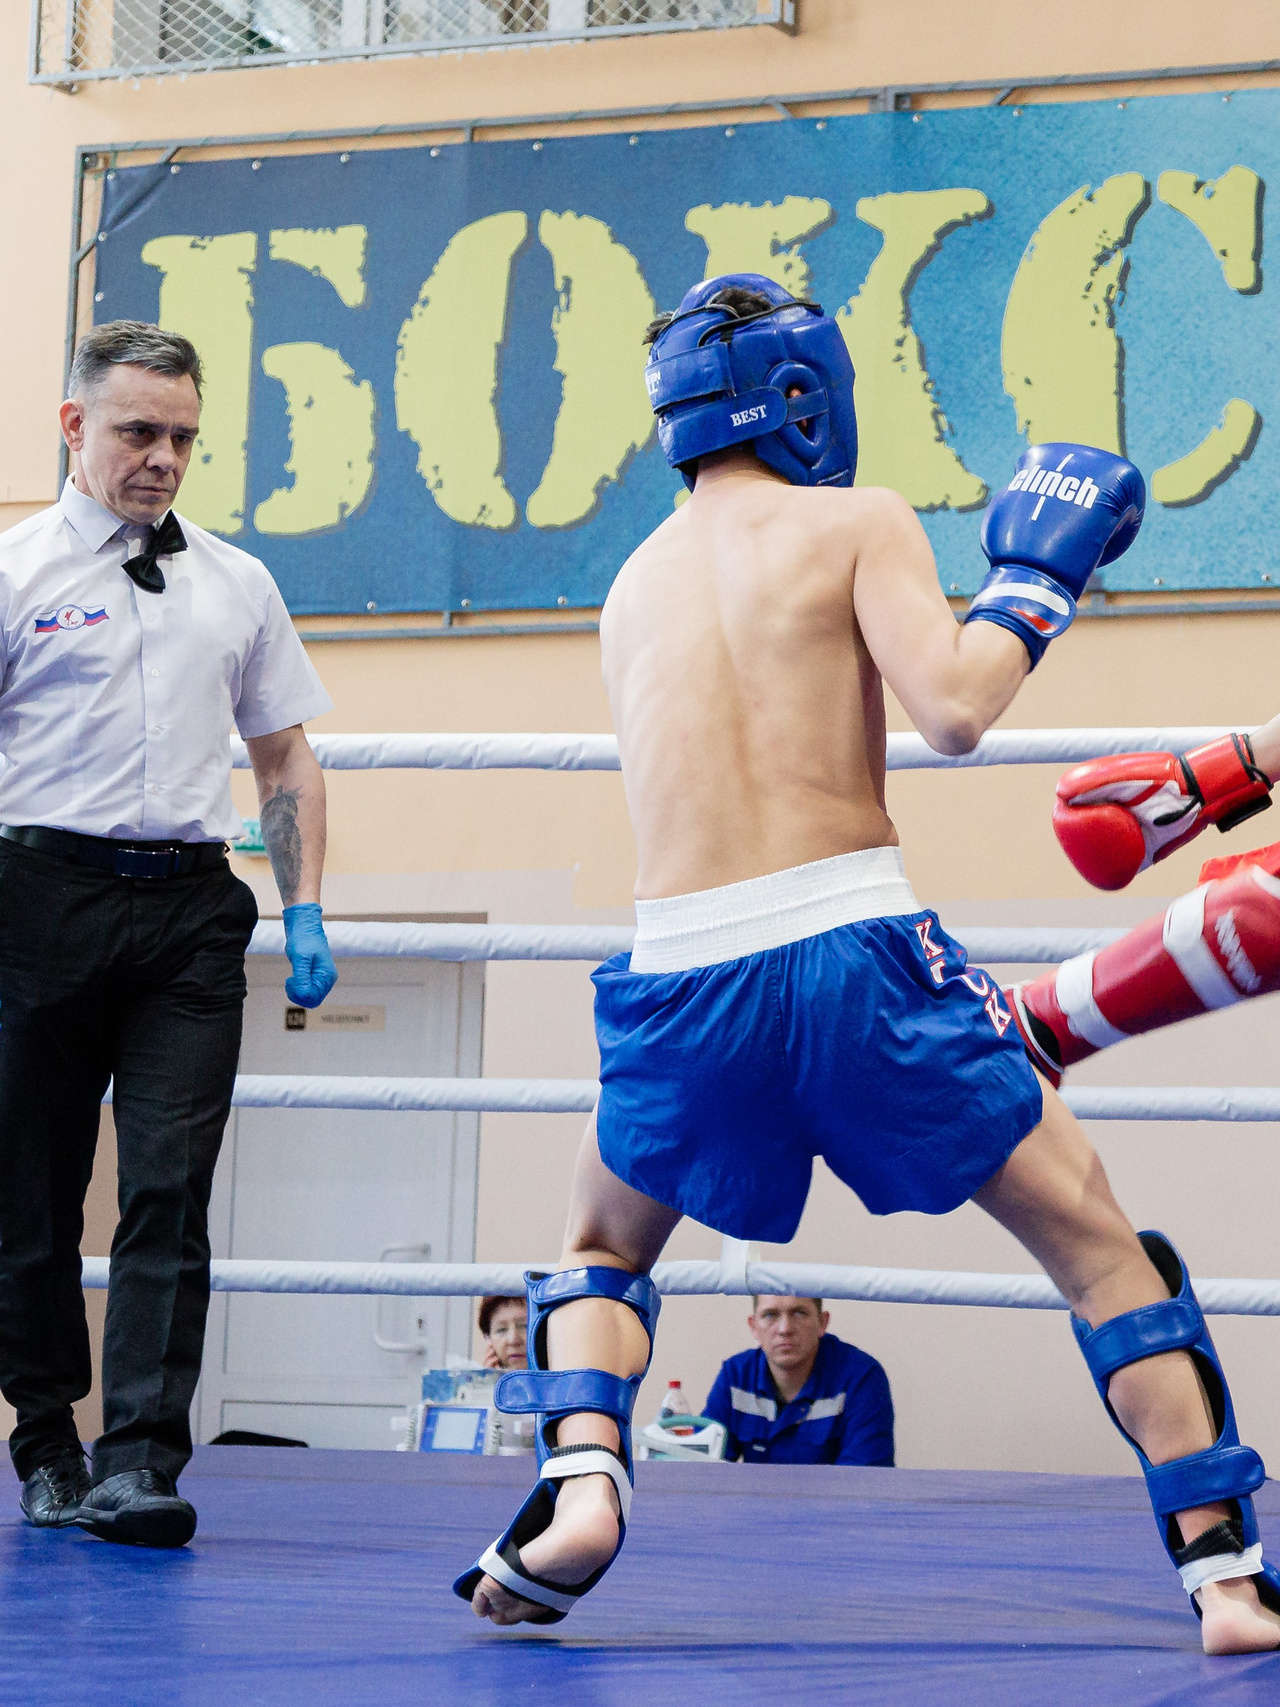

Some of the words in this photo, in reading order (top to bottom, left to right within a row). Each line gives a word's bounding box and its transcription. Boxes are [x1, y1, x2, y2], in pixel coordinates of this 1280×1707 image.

[141, 165, 1259, 535] БОКС
[730, 404, 767, 427] BEST
[1008, 464, 1099, 510] clinch
